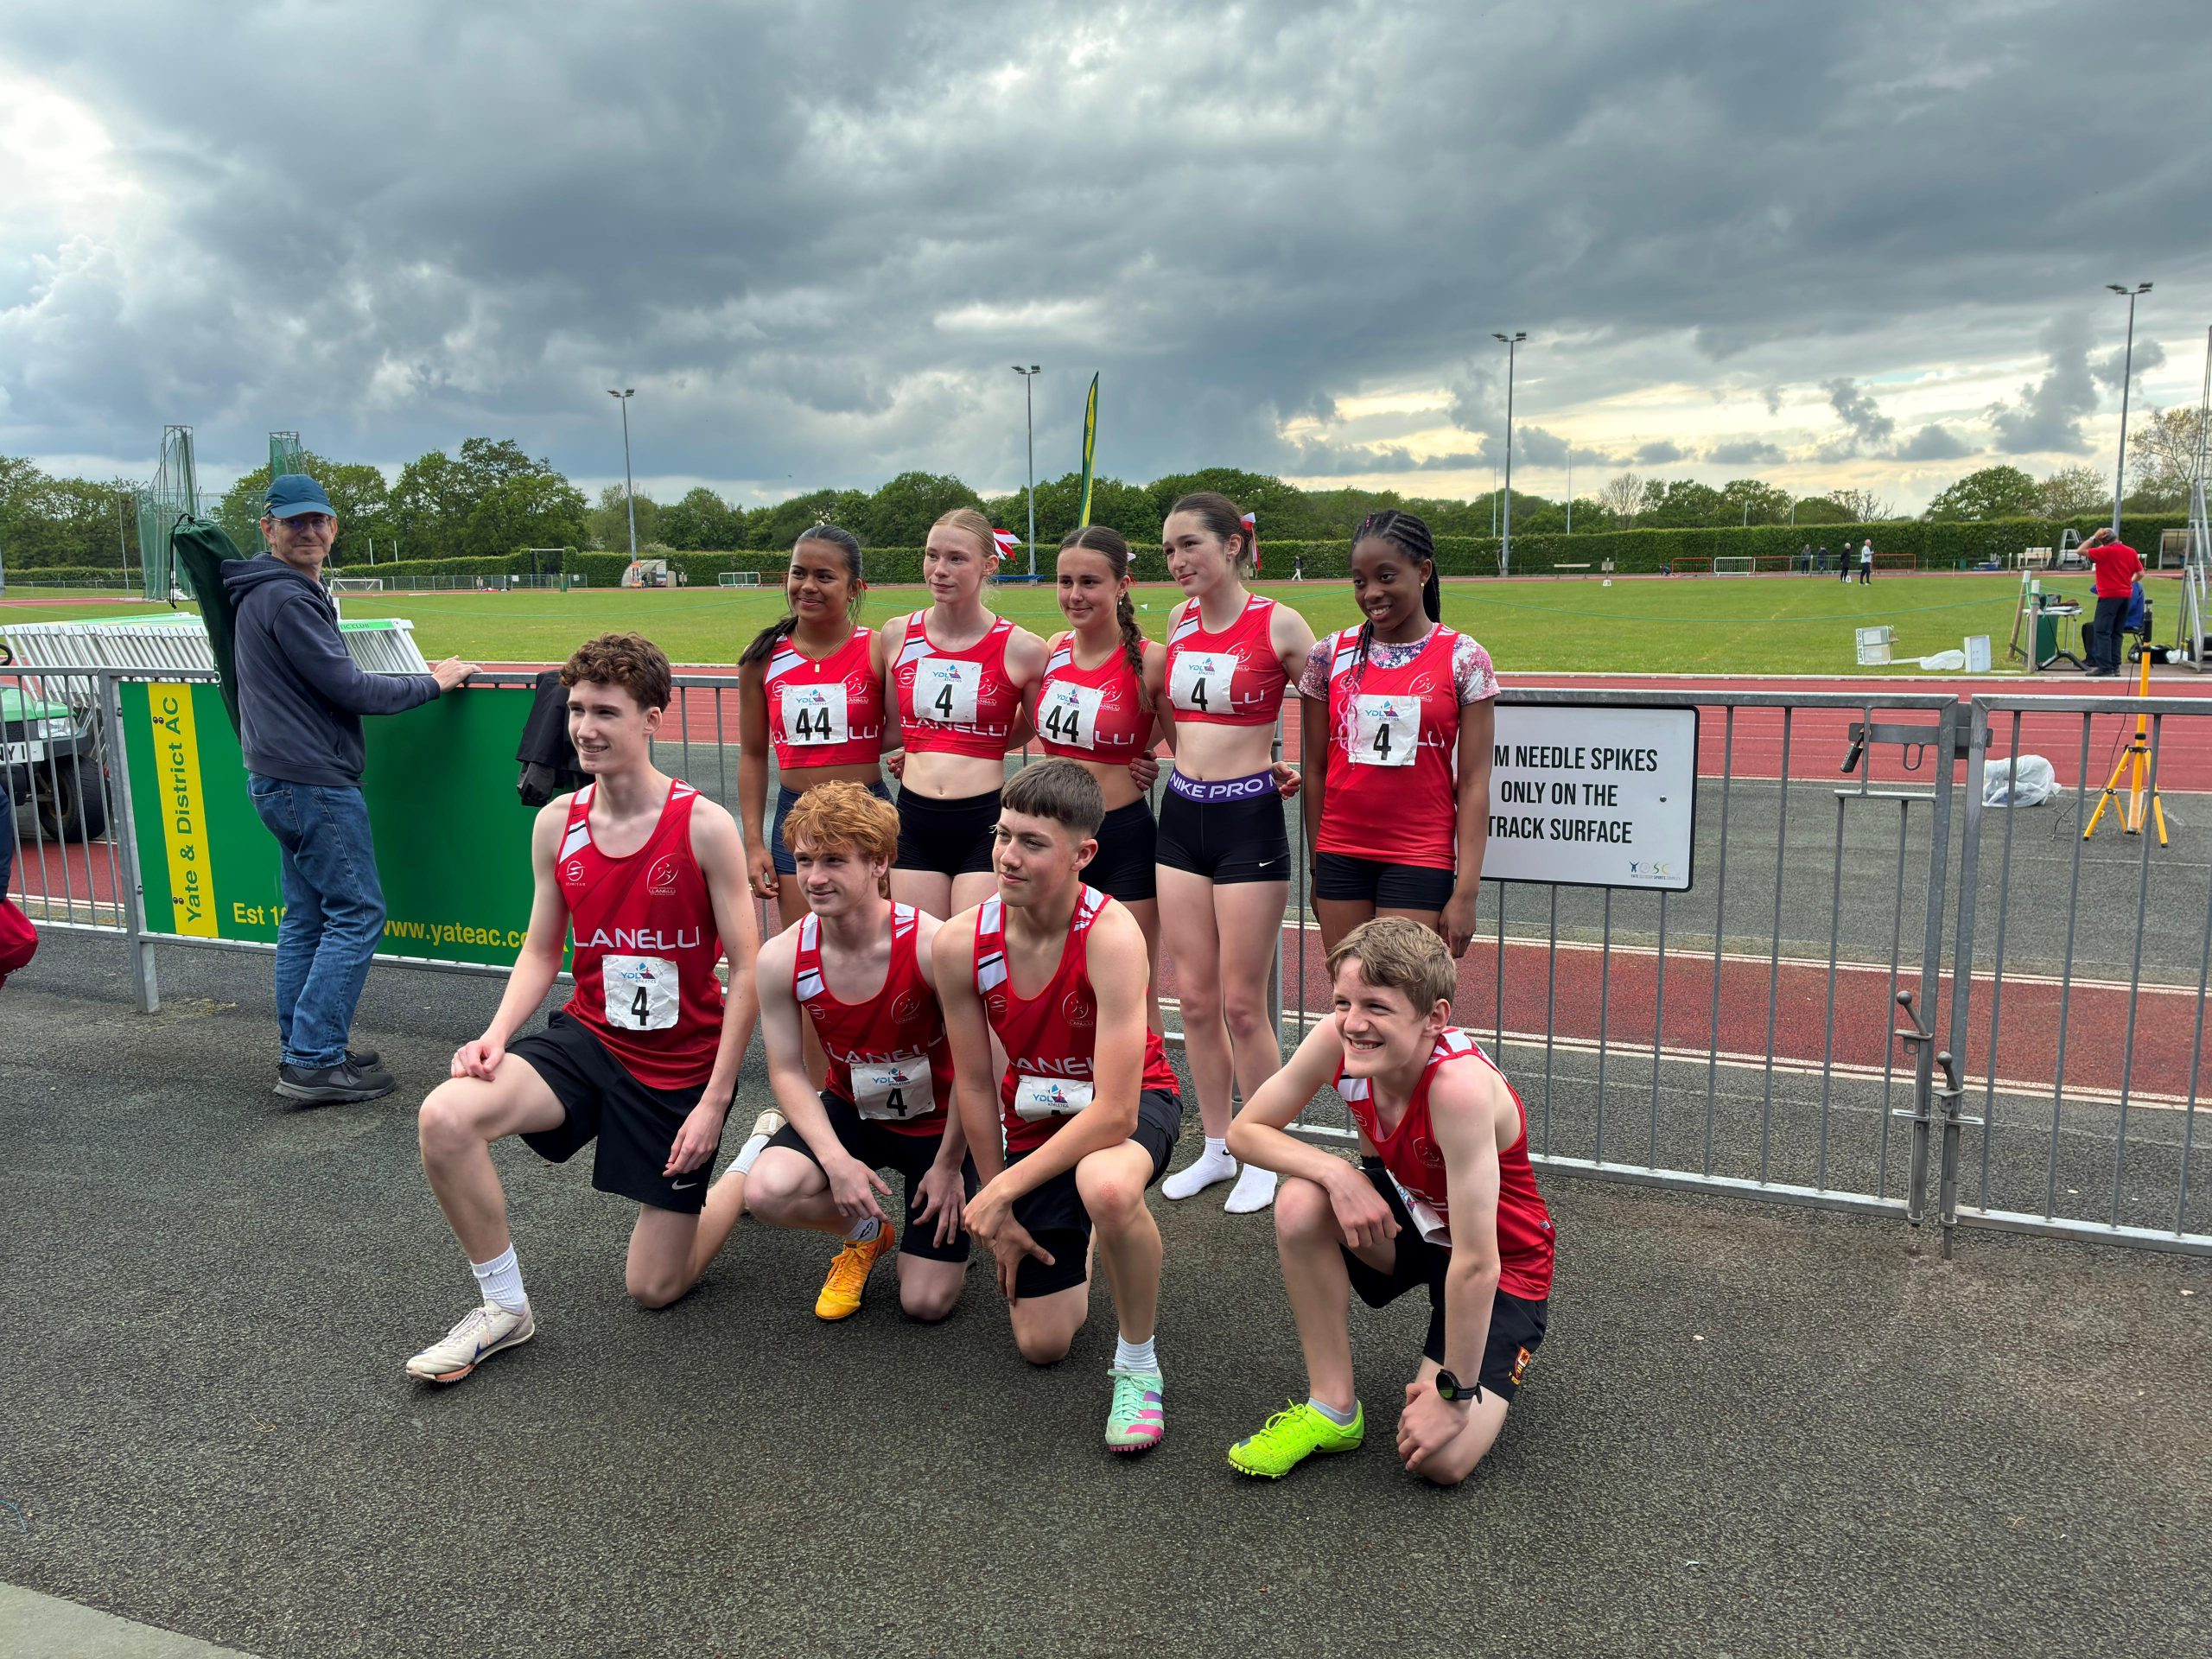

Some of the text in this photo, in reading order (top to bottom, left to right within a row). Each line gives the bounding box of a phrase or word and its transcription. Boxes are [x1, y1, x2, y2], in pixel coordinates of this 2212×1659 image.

[935, 683, 952, 718] 4
[1191, 677, 1208, 711] 4
[795, 707, 832, 741] 44
[1046, 704, 1080, 743] 44
[1373, 723, 1391, 760] 4
[1516, 745, 1586, 769] NEEDLE
[1591, 747, 1658, 772] SPIKES
[1169, 771, 1206, 798] NIKE
[1209, 779, 1264, 798] PRO
[1501, 780, 1618, 806] ONLY ON THE
[162, 696, 202, 922] Yate & District AC
[1488, 815, 1633, 844] TRACK SURFACE
[232, 902, 265, 925] Est
[631, 986, 650, 1026] 4
[886, 1088, 907, 1116] 4
[1033, 1094, 1053, 1103] YDL
